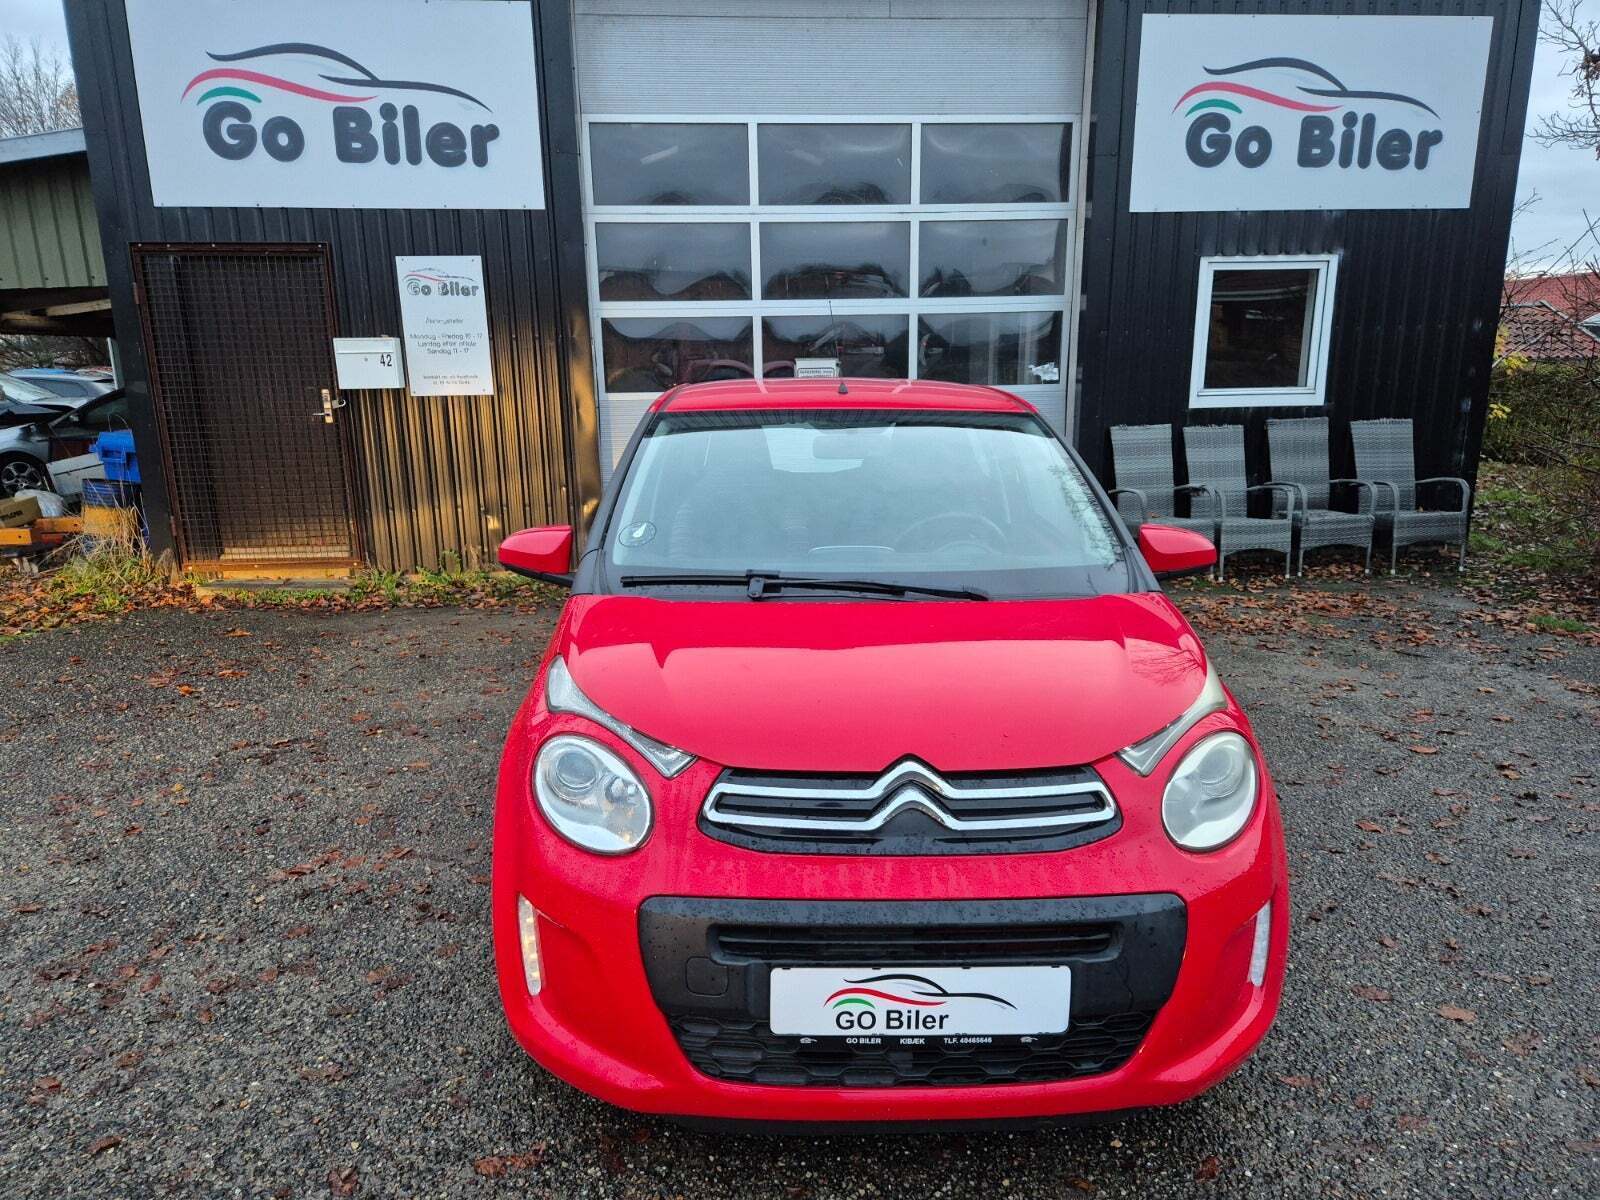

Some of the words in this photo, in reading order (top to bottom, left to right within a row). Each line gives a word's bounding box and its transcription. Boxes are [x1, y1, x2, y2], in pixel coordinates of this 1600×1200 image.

[202, 101, 305, 161] Go
[332, 102, 500, 167] Biler
[1185, 112, 1272, 169] Go
[1297, 111, 1443, 170] Biler
[407, 281, 432, 296] Go
[438, 281, 479, 296] Biler
[380, 353, 392, 366] 42
[835, 1010, 877, 1030] GO
[886, 1009, 949, 1030] Biler
